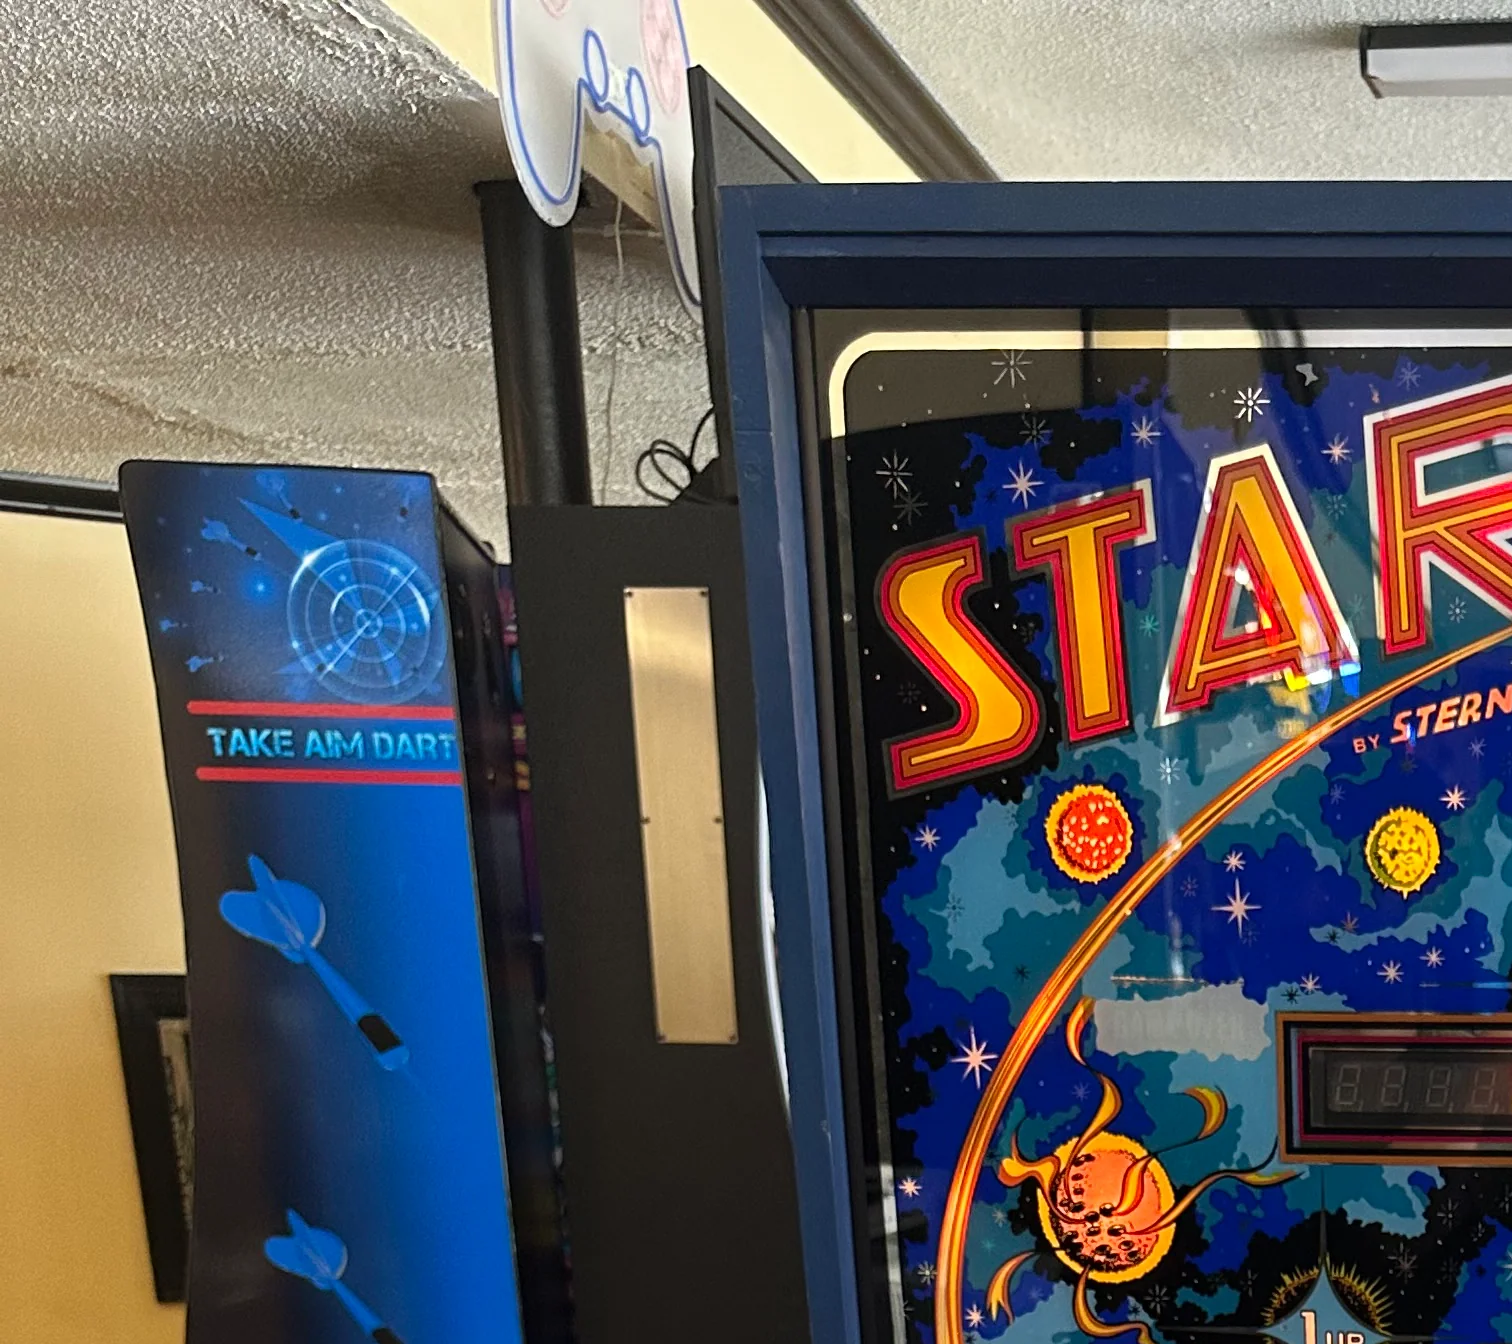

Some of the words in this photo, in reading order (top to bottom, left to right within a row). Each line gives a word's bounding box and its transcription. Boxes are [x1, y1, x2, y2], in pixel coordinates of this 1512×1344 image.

[207, 728, 294, 758] TAKE
[305, 730, 364, 760] AIM
[373, 732, 456, 761] DART
[1353, 734, 1380, 754] BY
